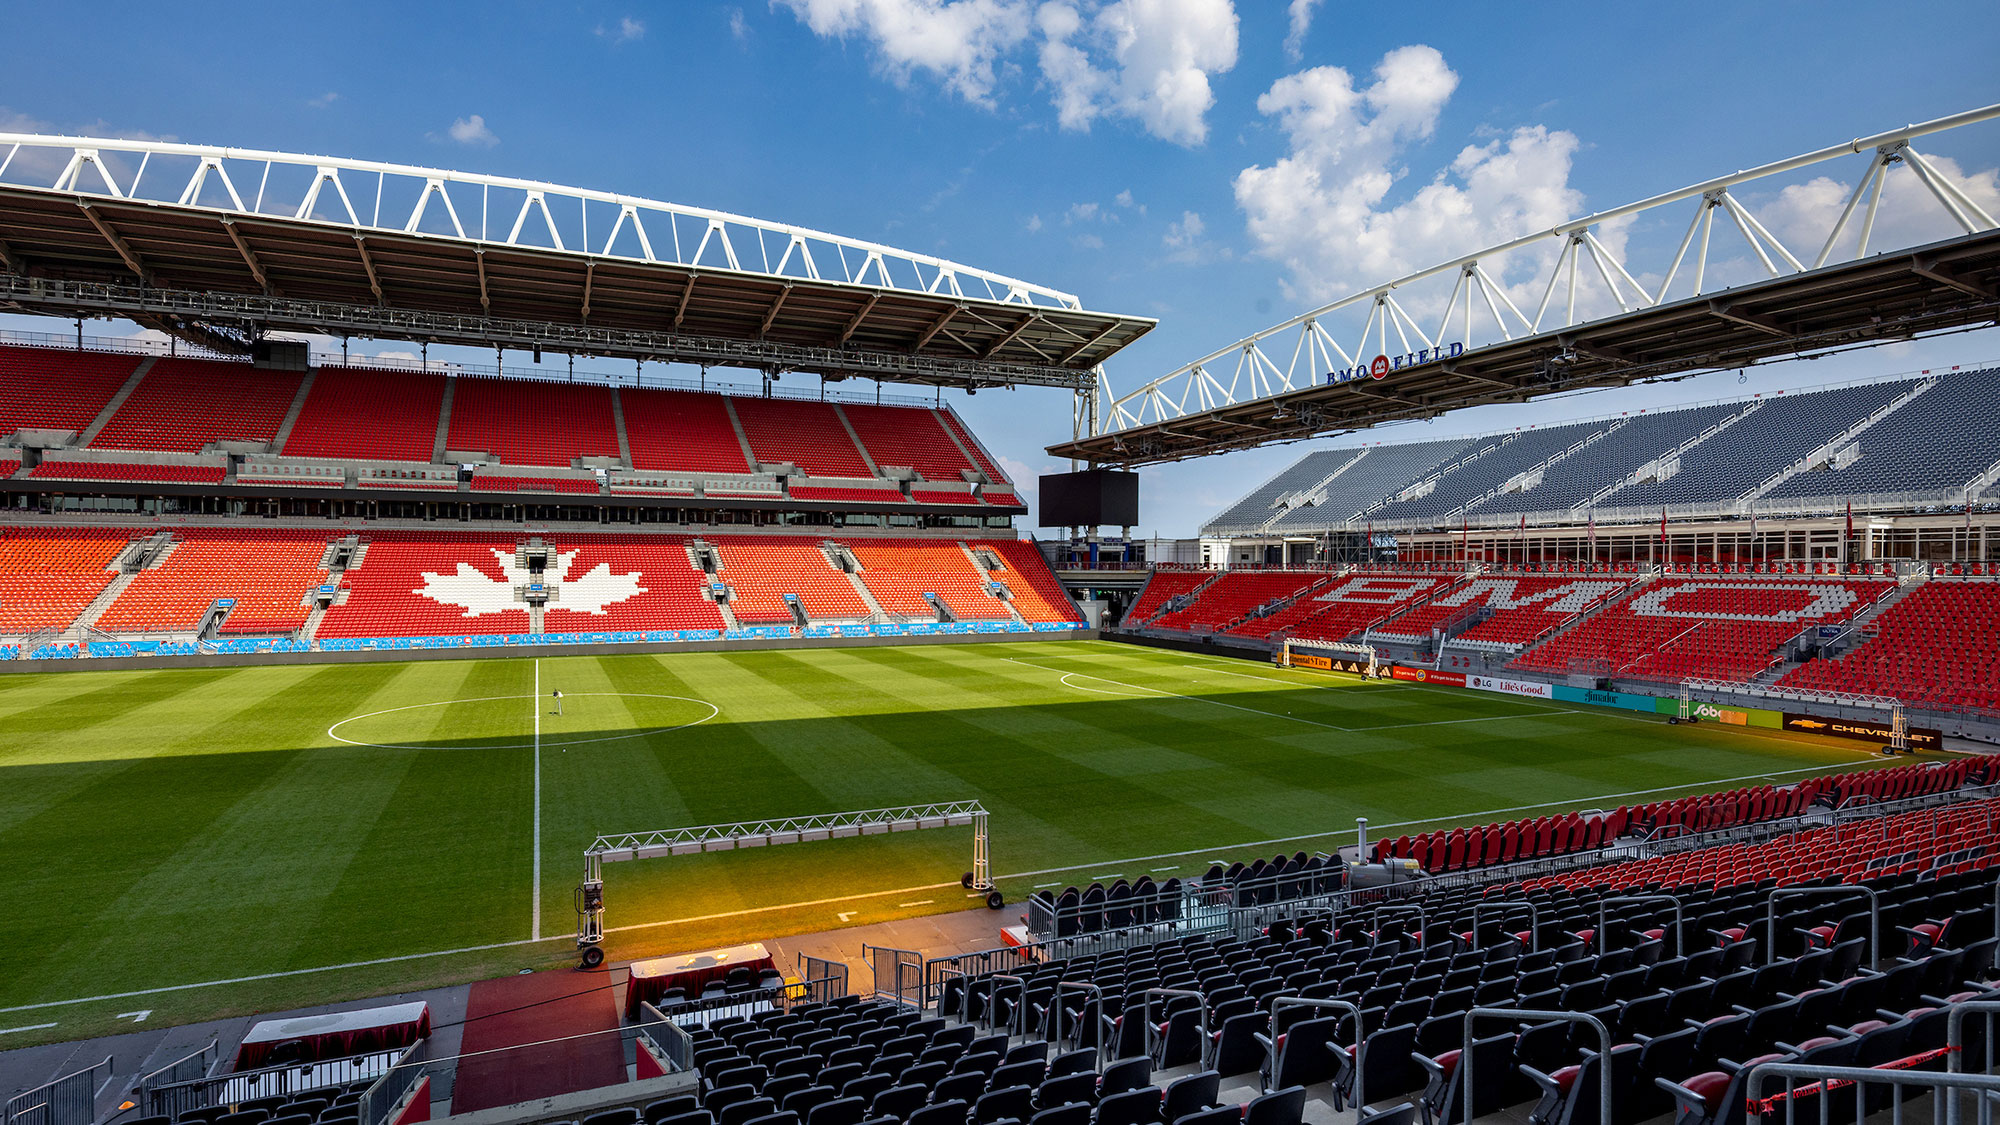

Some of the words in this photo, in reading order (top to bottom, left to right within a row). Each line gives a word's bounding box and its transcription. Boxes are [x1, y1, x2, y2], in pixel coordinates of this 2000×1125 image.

[1327, 364, 1368, 386] BMO
[1393, 341, 1465, 371] FIELD
[1312, 576, 1858, 622] BMO
[1281, 653, 1310, 664] ntinental
[1314, 657, 1328, 667] Tire
[1482, 680, 1492, 688] LG
[1500, 681, 1519, 692] Life's
[1520, 684, 1545, 695] Good.
[1832, 724, 1935, 742] CHEVROLET
